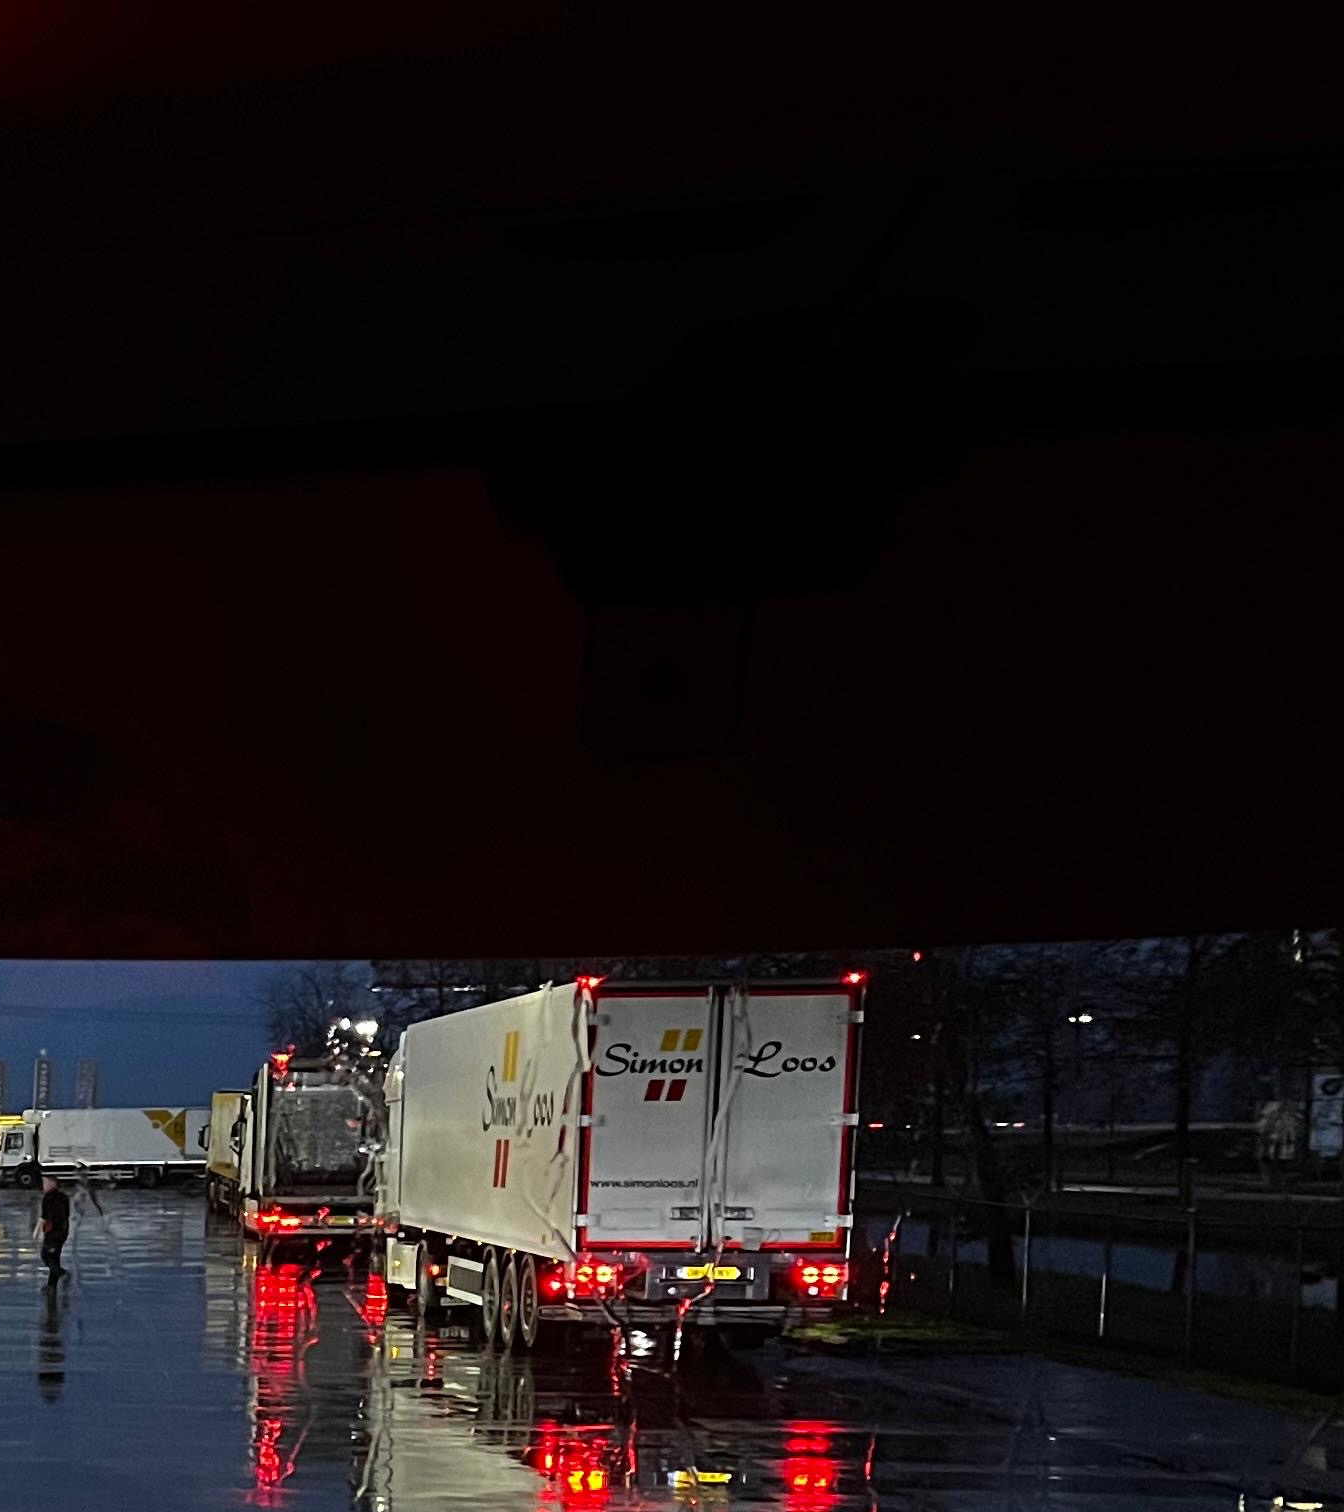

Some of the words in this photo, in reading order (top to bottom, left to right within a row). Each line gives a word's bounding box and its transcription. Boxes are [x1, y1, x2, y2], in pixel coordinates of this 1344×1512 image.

[595, 1042, 703, 1077] Simon
[738, 1040, 836, 1078] Loos
[590, 1177, 699, 1189] www.simonloos.nl
